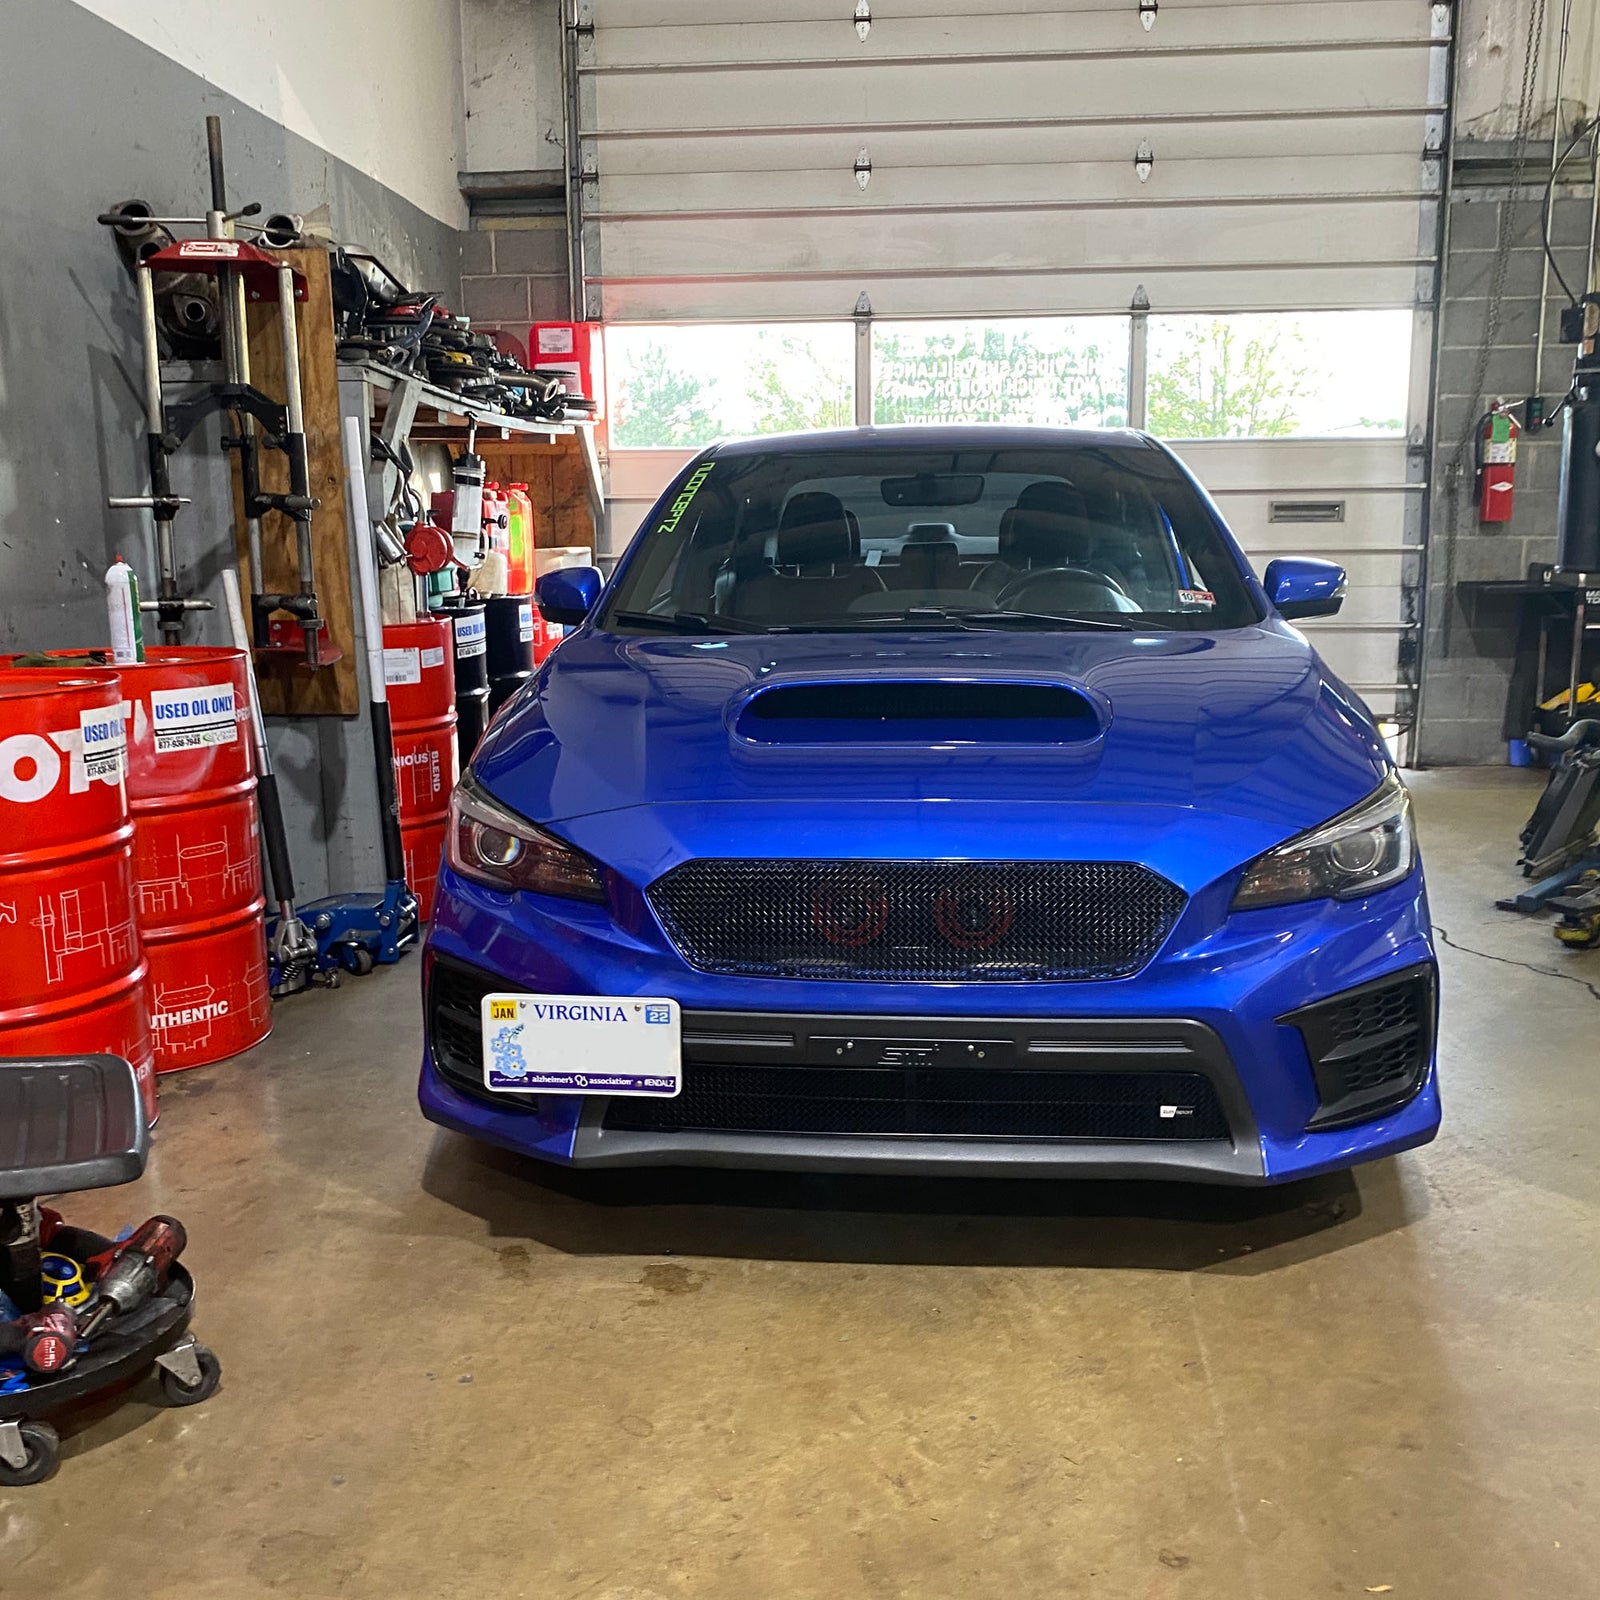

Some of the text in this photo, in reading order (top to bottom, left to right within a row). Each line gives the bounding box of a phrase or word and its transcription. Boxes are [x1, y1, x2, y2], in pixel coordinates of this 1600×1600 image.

[155, 695, 233, 720] USED OIL ONLY
[84, 723, 109, 743] USED
[431, 750, 440, 793] BLEND
[151, 1001, 229, 1028] UTHENTIC
[493, 1007, 515, 1019] JAN
[534, 1004, 628, 1022] VIRGINIA
[650, 1012, 669, 1023] 22
[531, 1075, 633, 1086] alzheimer's association
